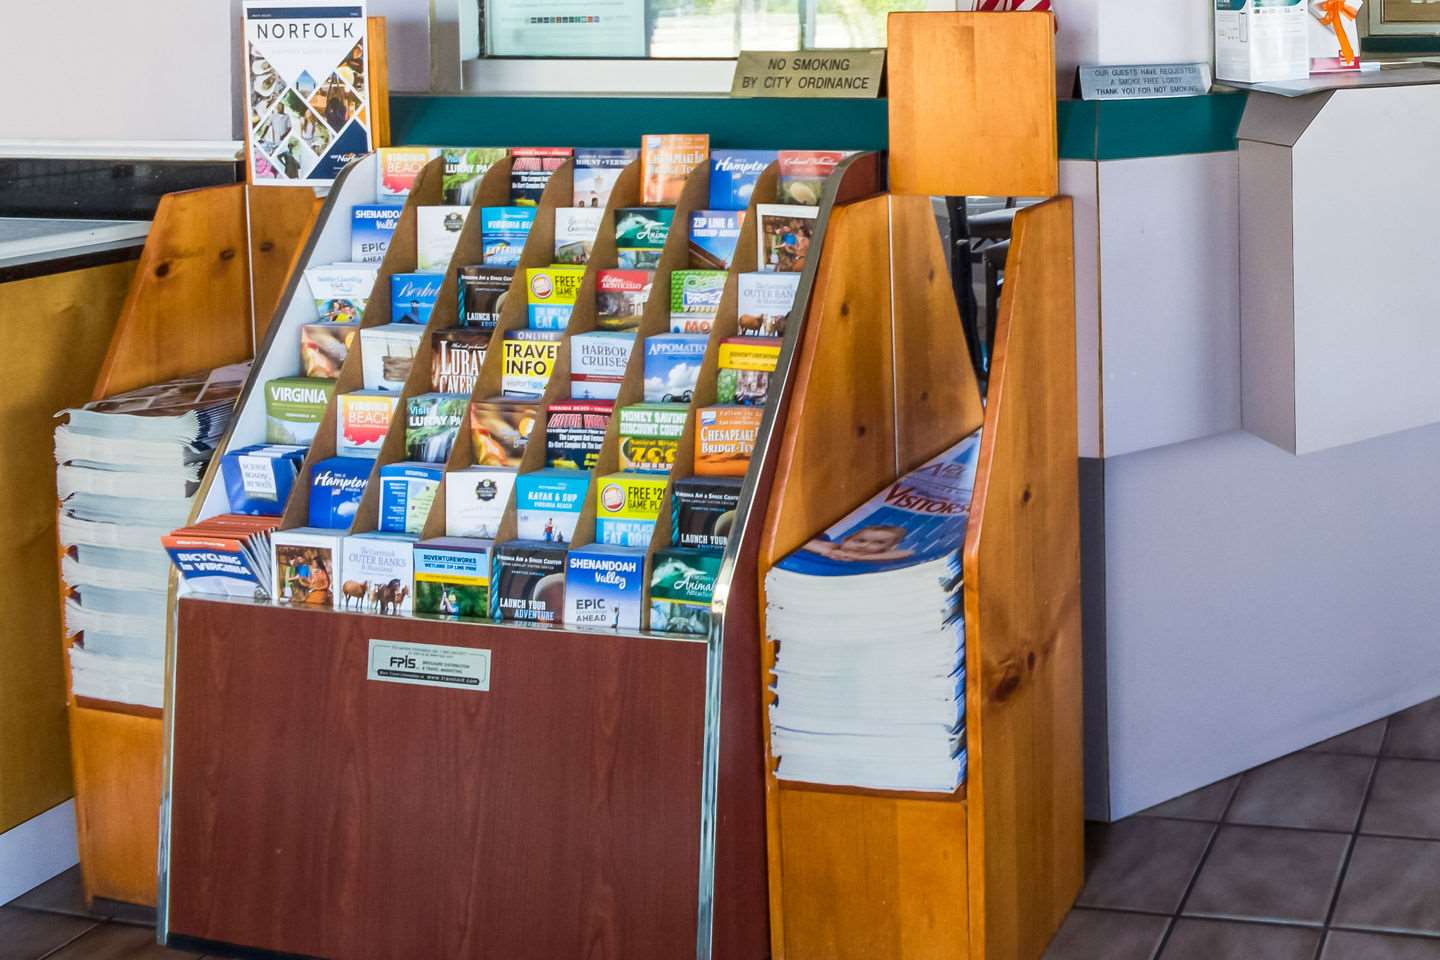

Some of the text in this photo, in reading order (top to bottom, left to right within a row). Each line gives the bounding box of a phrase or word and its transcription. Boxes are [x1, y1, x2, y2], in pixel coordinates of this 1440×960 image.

[257, 23, 354, 39] NORFOLK
[767, 58, 850, 71] NO SMOKING
[1094, 69, 1109, 77] OUR
[1111, 68, 1138, 77] GUESTS
[742, 76, 870, 89] BY CITY ORDINANCE
[1143, 77, 1160, 85] FREE
[1096, 88, 1120, 96] THANK
[1121, 87, 1136, 96] YOU
[1153, 86, 1167, 94] NOT
[361, 242, 386, 253] EPIC
[554, 275, 576, 288] FREE
[467, 312, 491, 321] LAUNCH
[517, 332, 555, 341] ONLINE
[581, 344, 627, 357] HARBOR
[506, 359, 547, 376] INFO
[581, 355, 628, 368] CRUISES
[270, 386, 328, 404] VIRGINIA
[350, 412, 390, 425] BEACH
[409, 416, 448, 426] LURAY
[314, 470, 369, 490] Hampton
[528, 491, 578, 502] KAYAK & SUP
[628, 486, 651, 500] FREE
[628, 499, 648, 510] GAME
[681, 533, 708, 544] LAUNCH
[178, 552, 241, 565] BICYCLING
[349, 551, 407, 567] OUTER BANKS
[423, 553, 477, 564] ADVENTUREWORKS
[194, 562, 251, 576] VIRGINIA
[570, 558, 636, 573] SHENANDOAH
[594, 572, 626, 590] Valley
[499, 597, 546, 610] LAUNCH YOUR
[575, 598, 606, 610] EPIC
[513, 609, 554, 621] ADVENTURE
[576, 613, 607, 623] AHEAD
